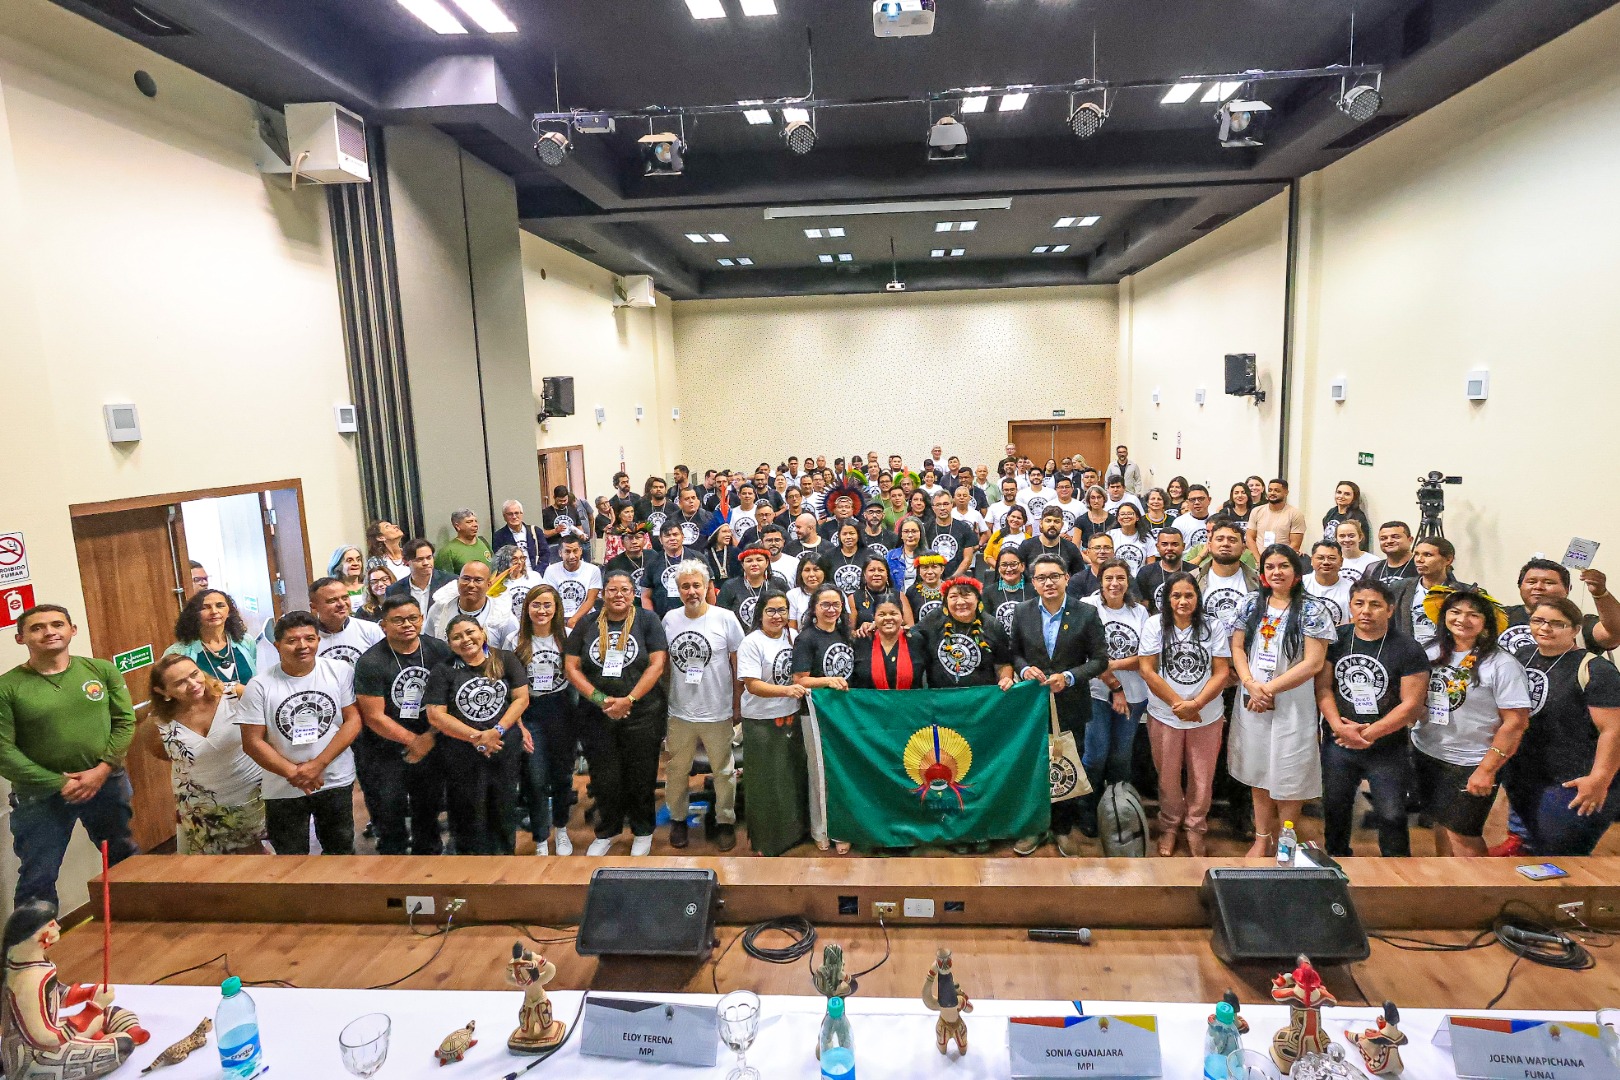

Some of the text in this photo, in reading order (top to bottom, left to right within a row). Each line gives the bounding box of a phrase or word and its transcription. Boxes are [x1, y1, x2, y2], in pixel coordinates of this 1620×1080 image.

[0, 565, 26, 573] ROIBIDO
[1, 571, 24, 579] FUMAR
[622, 1032, 673, 1045] ELOY TERENA
[638, 1047, 654, 1057] MPI
[1045, 1049, 1124, 1058] SONIA GUAJAJARA
[1489, 1054, 1585, 1068] JOENIA WAPICHANA
[1077, 1063, 1094, 1071] MPI
[1524, 1070, 1555, 1080] FUNAI
